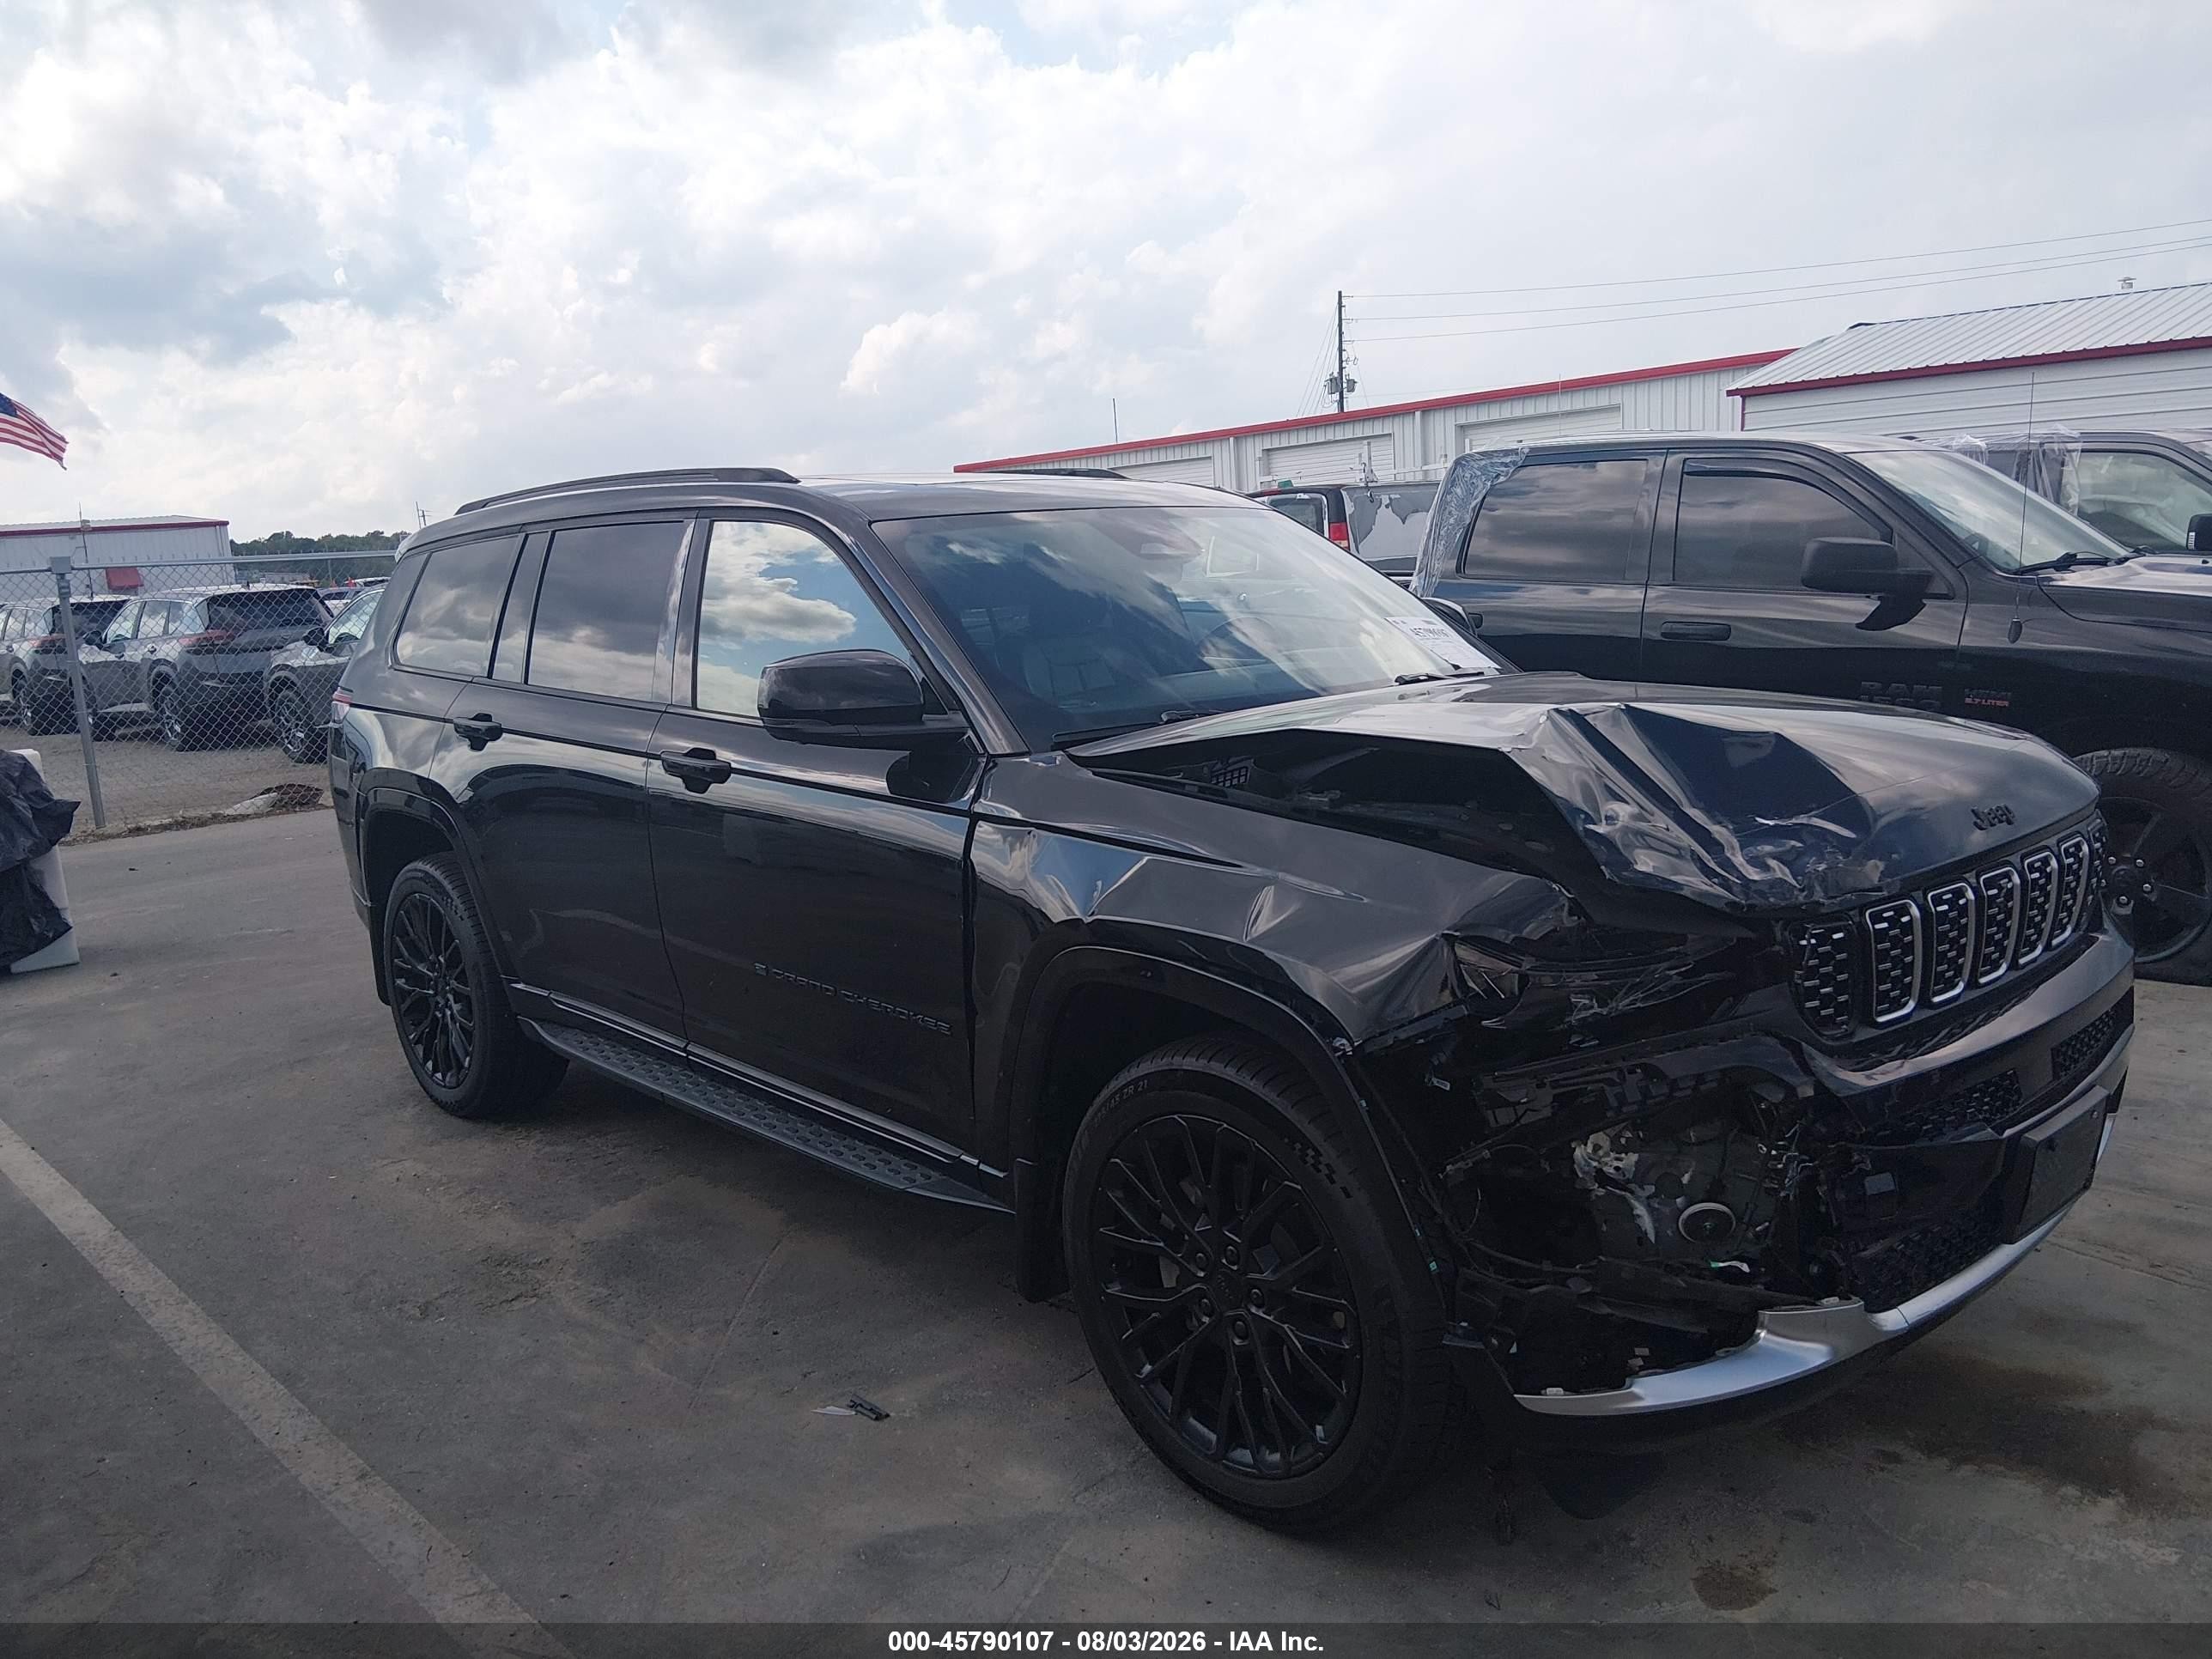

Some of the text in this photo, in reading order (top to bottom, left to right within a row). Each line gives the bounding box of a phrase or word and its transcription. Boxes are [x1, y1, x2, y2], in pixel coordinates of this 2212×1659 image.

[1861, 681, 1942, 696] RAM
[1971, 803, 2014, 831] Jeep
[772, 968, 951, 1036] GRAND CHEROKEE
[1137, 1079, 1148, 1091] 21
